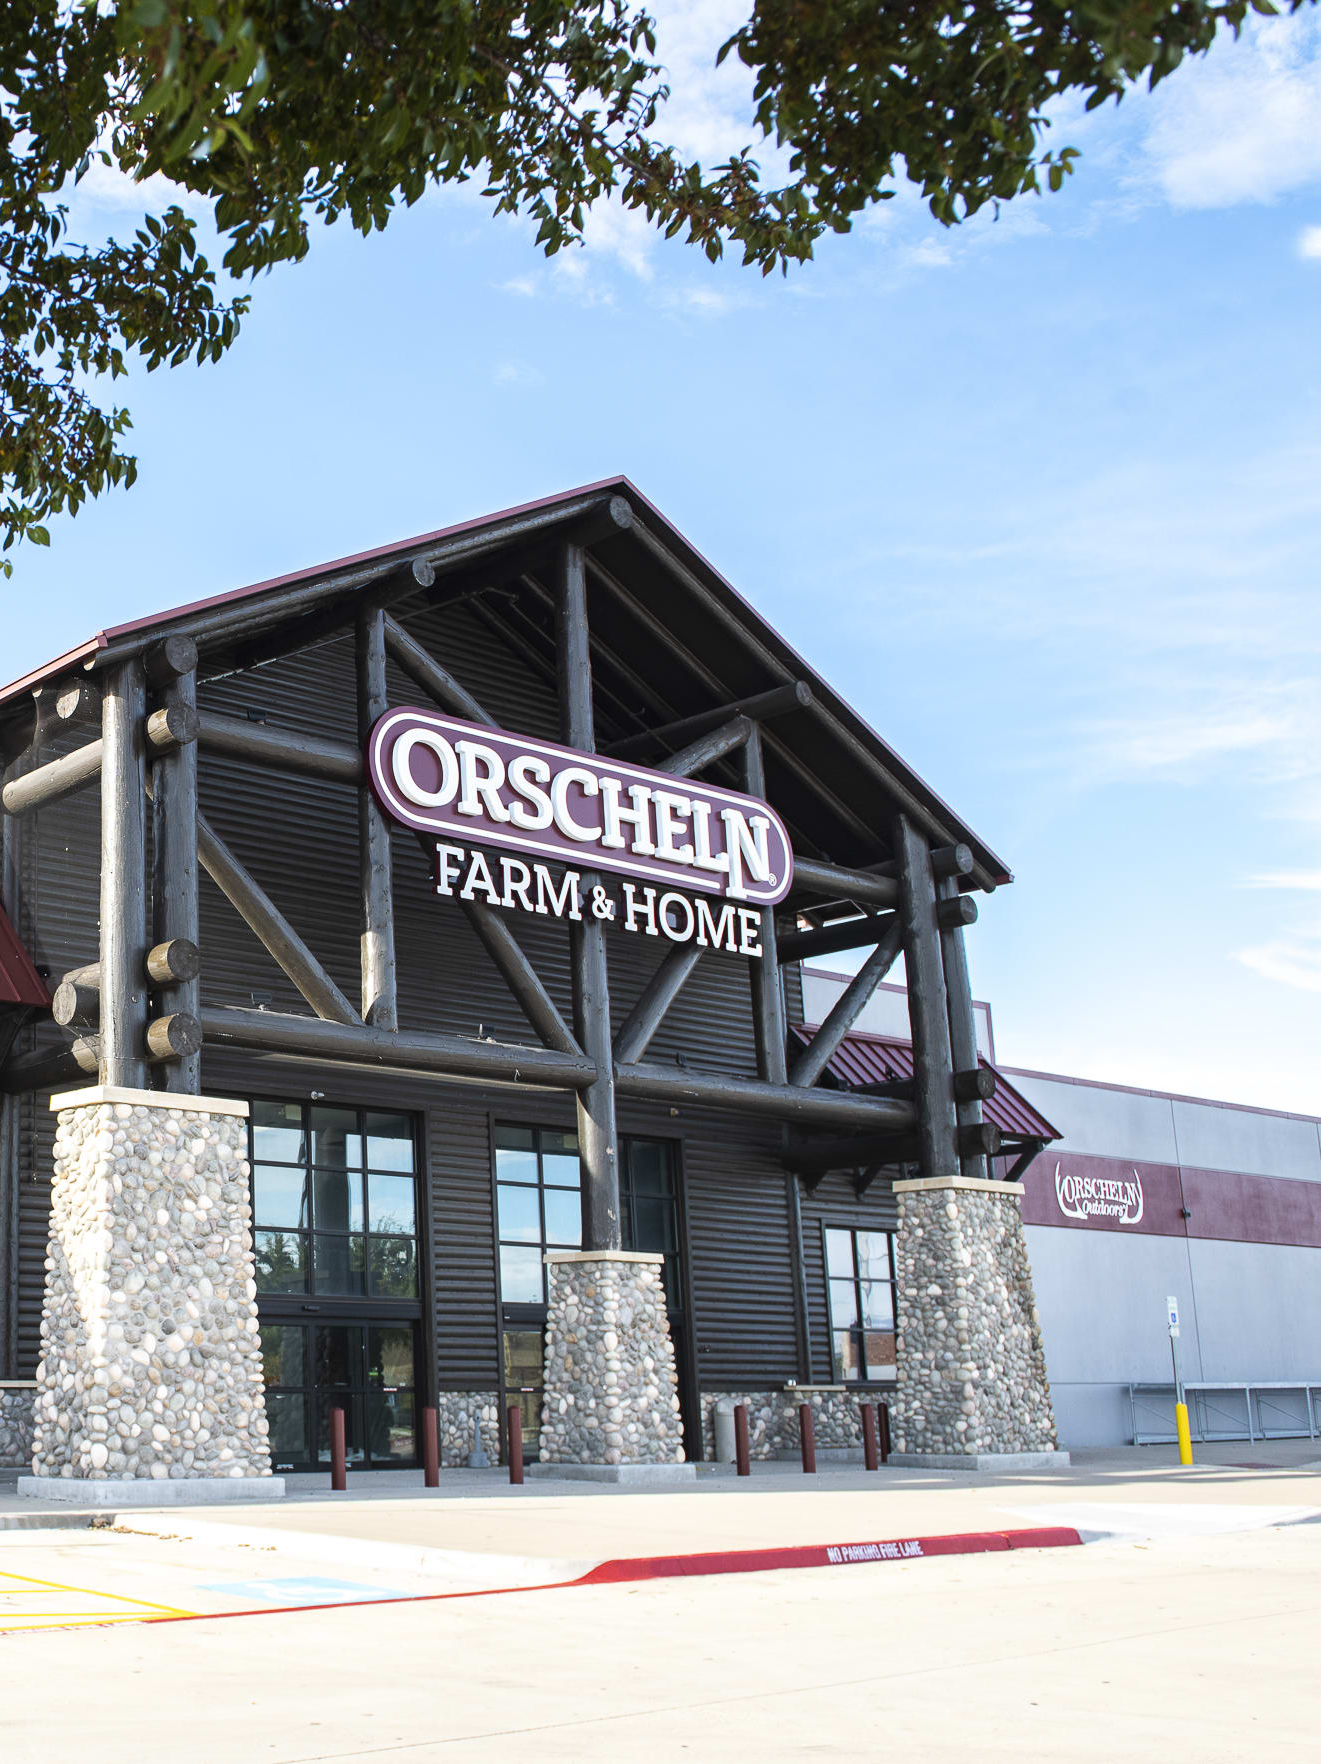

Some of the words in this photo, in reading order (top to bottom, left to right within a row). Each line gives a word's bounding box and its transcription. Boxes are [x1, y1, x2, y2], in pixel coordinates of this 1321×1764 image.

[392, 727, 770, 899] ORSCHELN
[435, 842, 583, 922] FARM
[591, 885, 615, 921] &
[622, 883, 764, 958] HOME
[1062, 1175, 1138, 1206] ORSCHELN
[1082, 1200, 1125, 1216] Outdoors
[826, 1546, 843, 1563] NO
[841, 1544, 881, 1562] PARKING
[879, 1541, 902, 1558] FIRE
[899, 1540, 924, 1556] LANE
